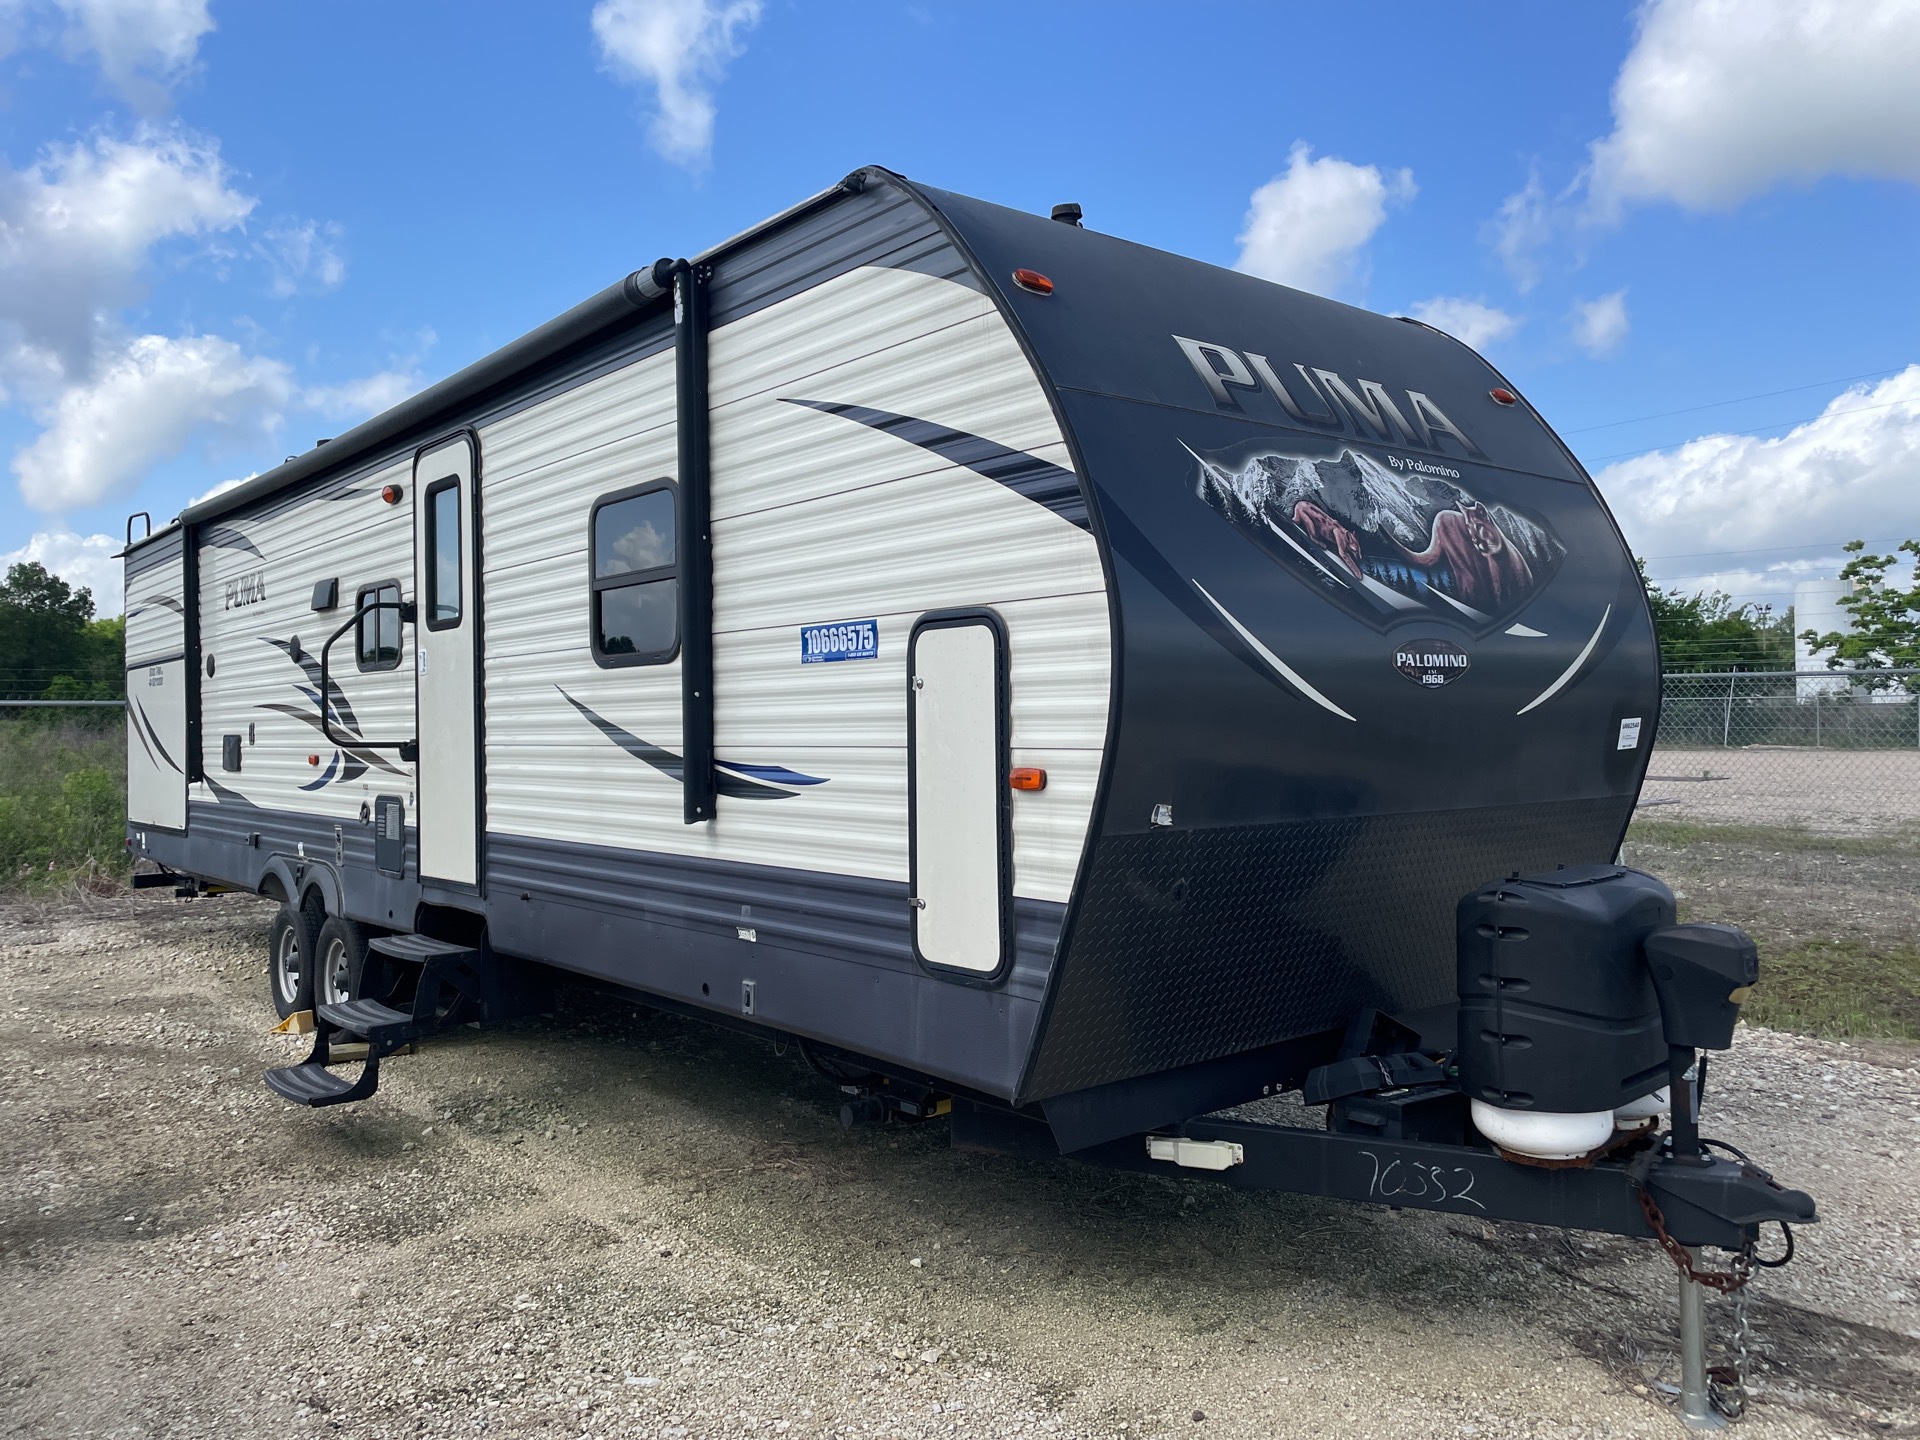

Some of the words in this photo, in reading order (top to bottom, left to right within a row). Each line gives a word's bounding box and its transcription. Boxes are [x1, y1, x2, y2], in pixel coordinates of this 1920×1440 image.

[1171, 334, 1491, 461] PUMA
[1387, 455, 1404, 471] By
[1405, 458, 1460, 479] Palomino
[225, 570, 266, 611] PUMA
[804, 624, 874, 654] 10666575
[1396, 652, 1467, 667] PALOMINO
[1422, 675, 1444, 684] 1968
